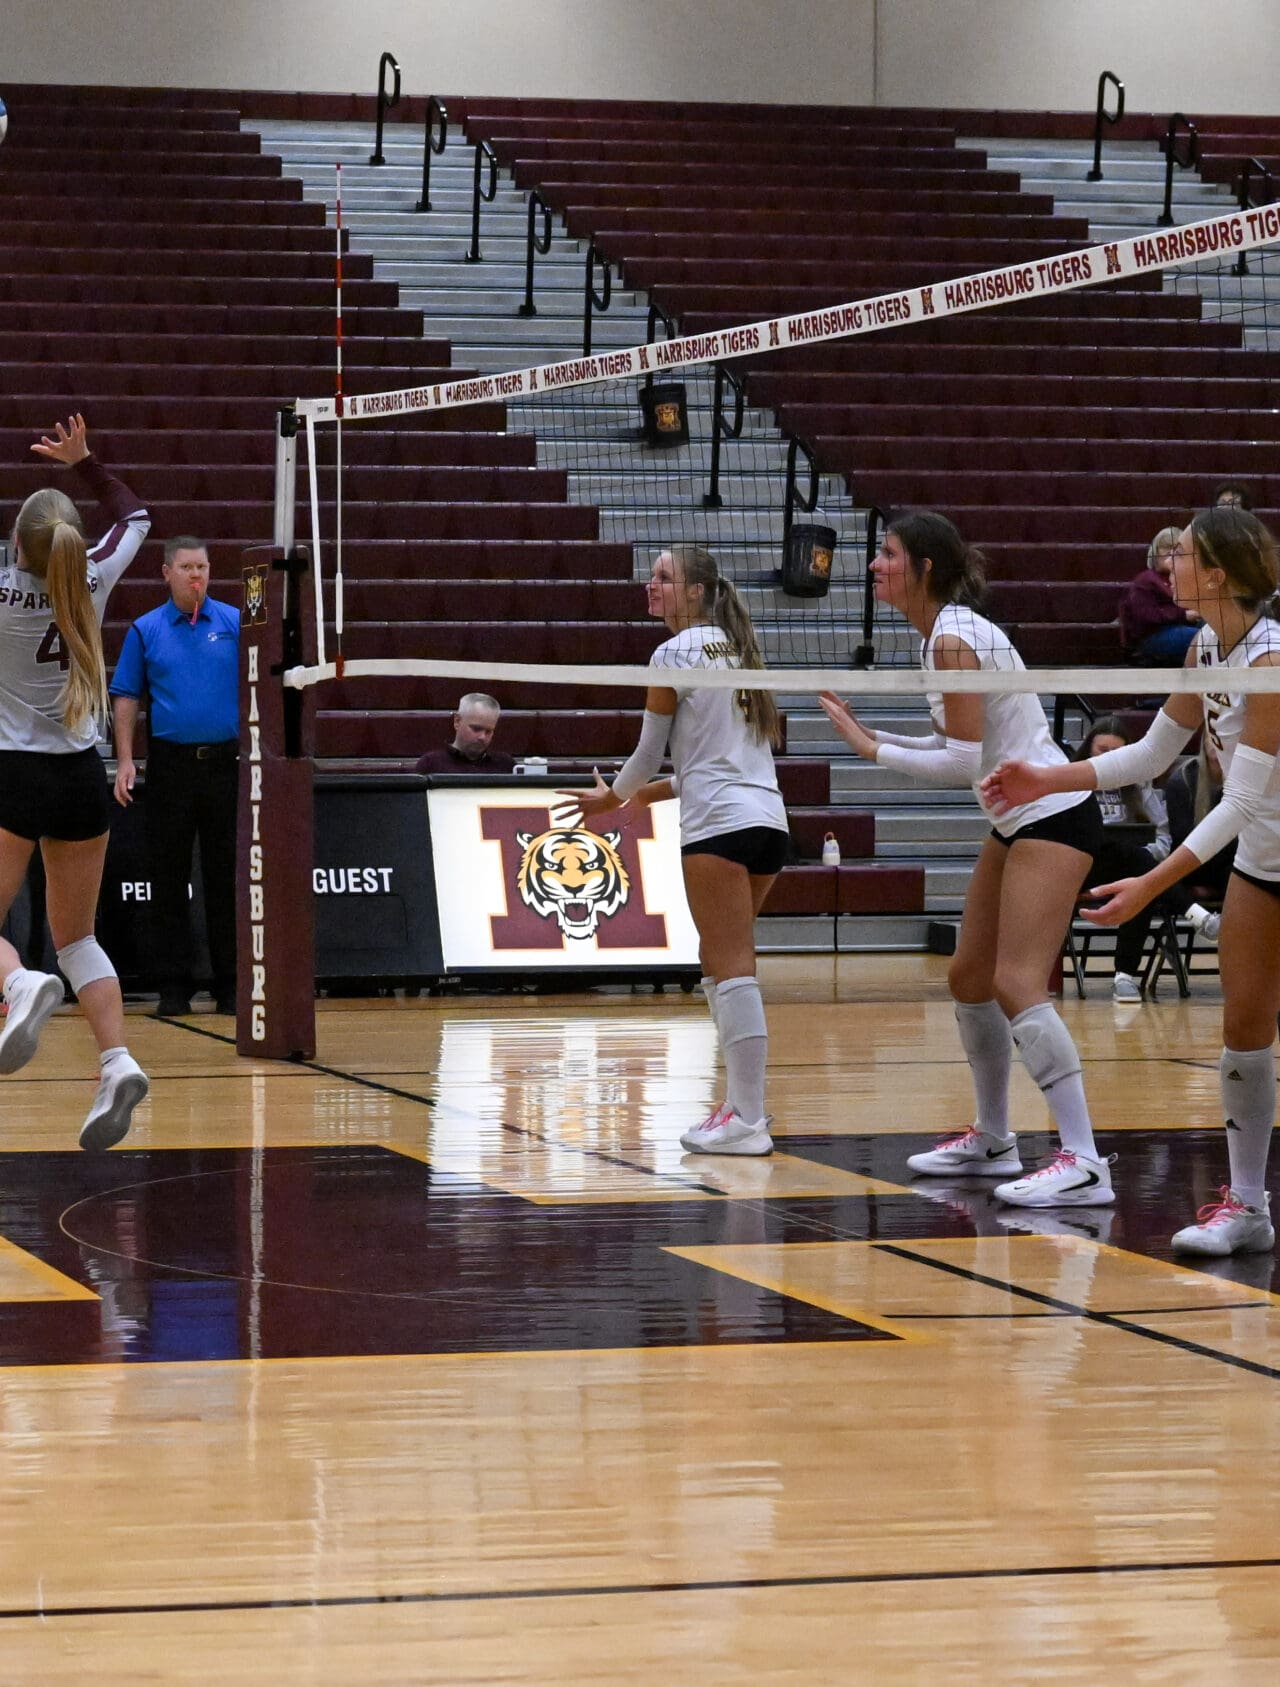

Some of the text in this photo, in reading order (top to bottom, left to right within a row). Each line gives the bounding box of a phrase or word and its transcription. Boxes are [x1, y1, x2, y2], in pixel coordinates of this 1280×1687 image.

[362, 208, 1280, 415] HARRISBURG TIGERS HARRISBURG TIGERS HARRISBURG TIGERS HARRISBURG TIGERS HARRISBURG TIGERS HARRISBURG TIGERS HARRISBURG TIG
[35, 621, 70, 672] 4
[248, 645, 266, 1041] HARRISBURG
[312, 867, 394, 894] GUEST
